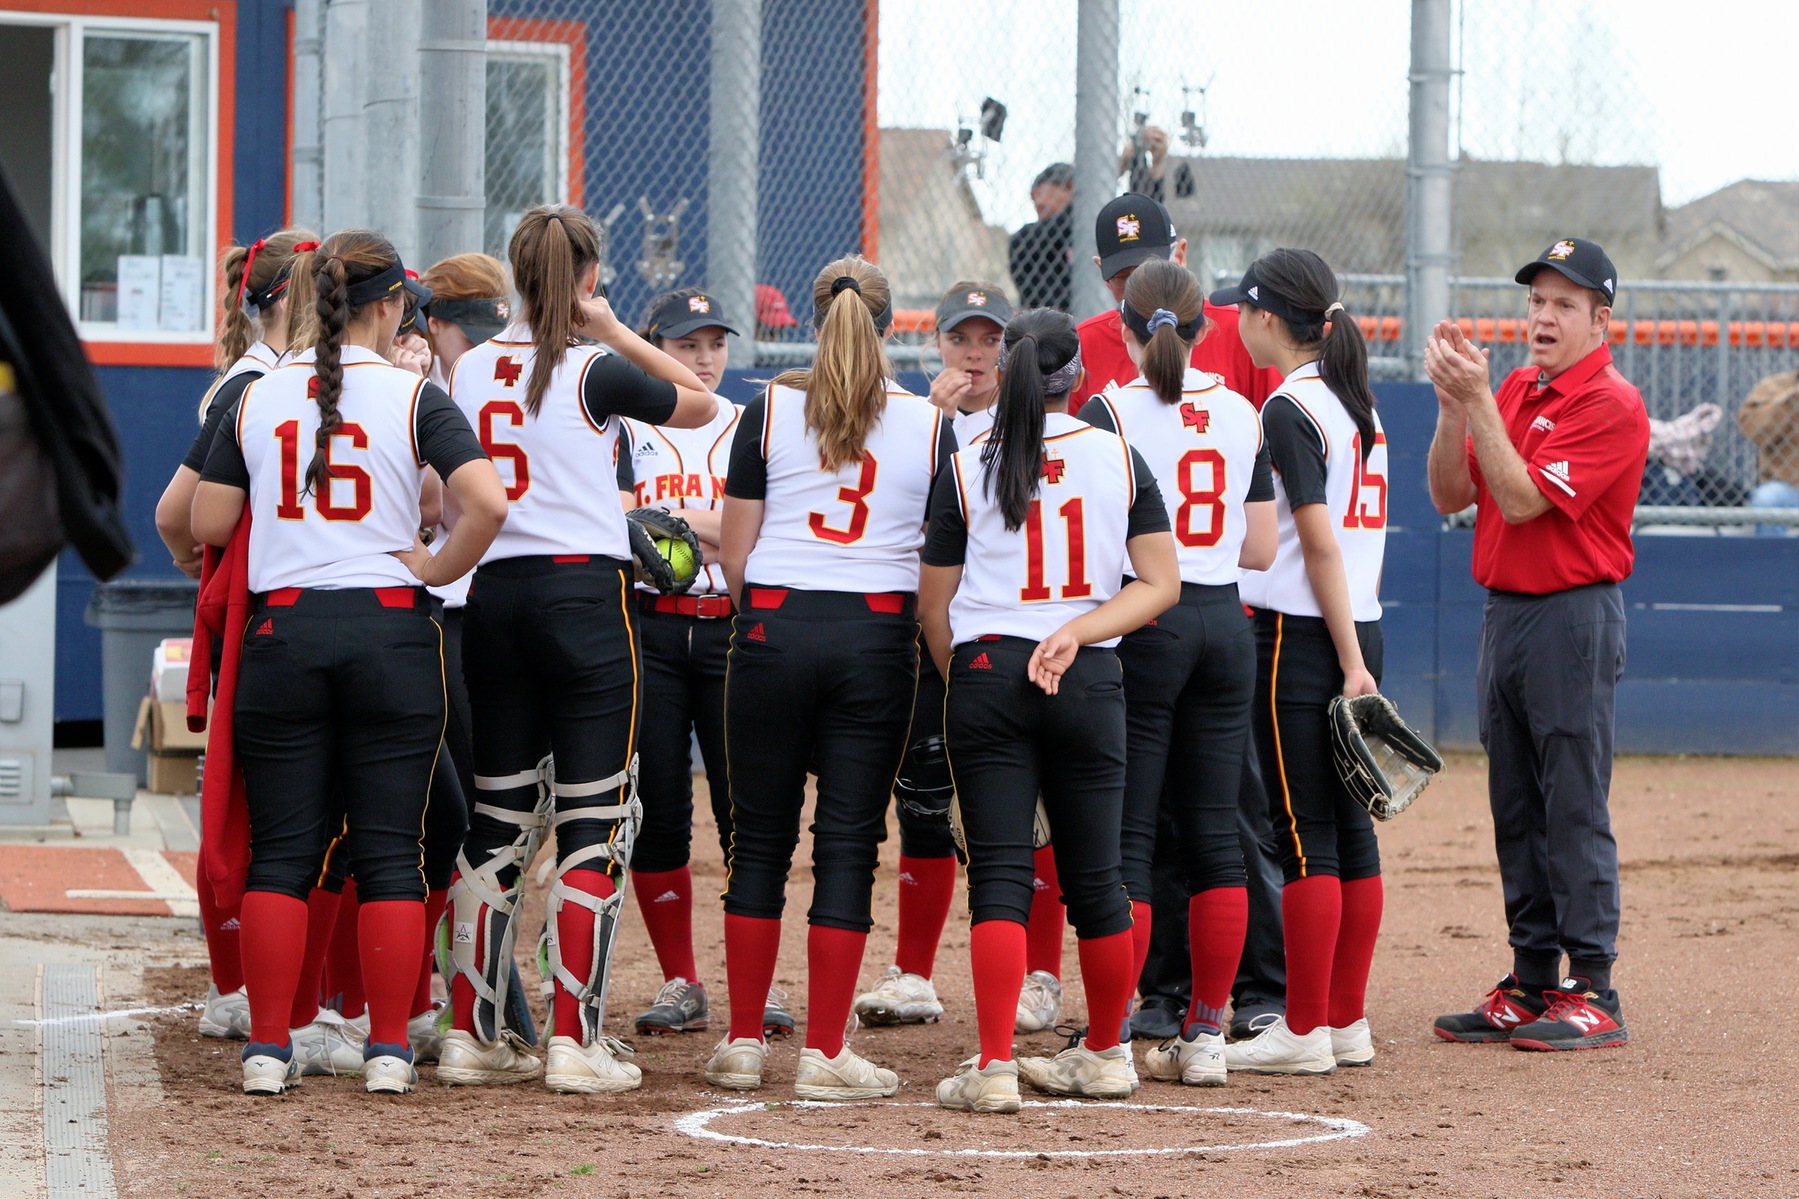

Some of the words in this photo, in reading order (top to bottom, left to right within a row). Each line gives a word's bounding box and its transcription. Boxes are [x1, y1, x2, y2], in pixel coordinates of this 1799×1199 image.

[1116, 215, 1140, 237] SF
[1549, 240, 1575, 257] SF
[688, 295, 710, 314] SF
[967, 291, 987, 306] SF
[494, 355, 523, 388] SF
[1179, 401, 1211, 434] SF
[478, 400, 531, 503] 6
[273, 418, 374, 523] 16
[1342, 430, 1388, 531] 15
[1545, 464, 1571, 482] adidas
[807, 446, 879, 547] 3
[1175, 447, 1228, 549] 8
[1020, 496, 1093, 603] 11
